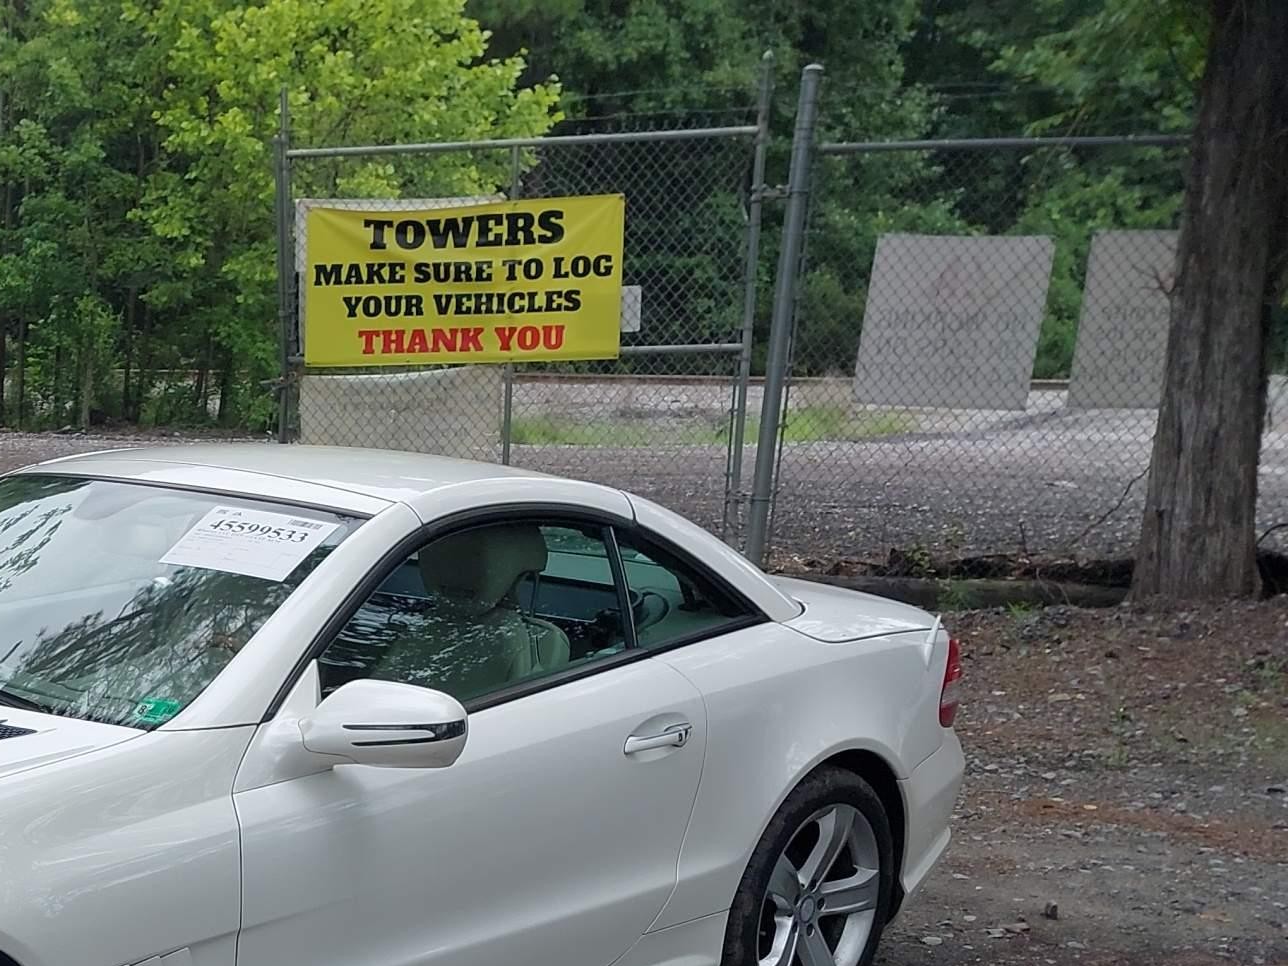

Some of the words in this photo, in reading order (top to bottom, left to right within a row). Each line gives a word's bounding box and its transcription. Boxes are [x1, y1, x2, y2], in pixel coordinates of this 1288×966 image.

[364, 210, 565, 250] TOWERS
[313, 262, 405, 286] MAKE
[414, 260, 493, 283] SURE
[502, 258, 544, 281] TO
[552, 255, 613, 278] LOG
[342, 294, 425, 318] YOUR
[432, 289, 581, 316] VEHICLES
[358, 327, 484, 354] THANK
[494, 324, 565, 351] YOU
[209, 519, 308, 542] 45599533
